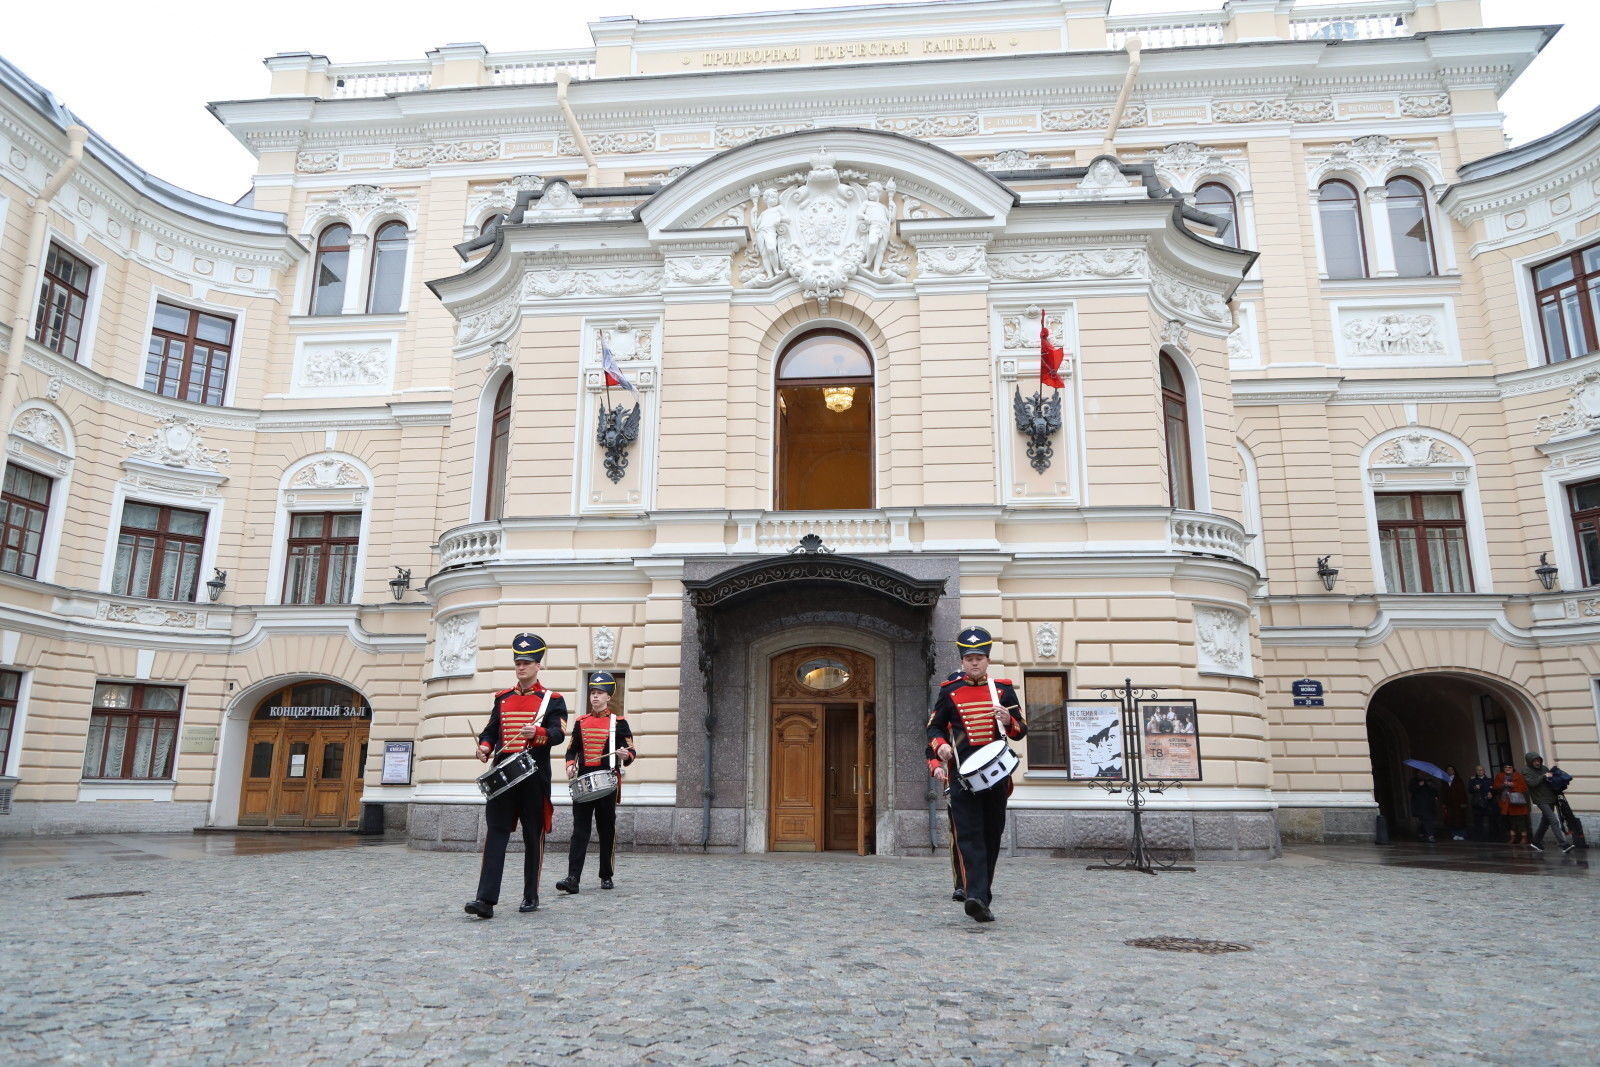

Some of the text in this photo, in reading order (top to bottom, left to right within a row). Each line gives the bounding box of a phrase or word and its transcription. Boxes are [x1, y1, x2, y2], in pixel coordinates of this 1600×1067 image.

[703, 47, 800, 66] ПРИДВОРНАЯ
[923, 37, 996, 53] КАПЕЛЛА
[270, 705, 365, 718] КОНЦЕРТНЫЙ ЗАЛ
